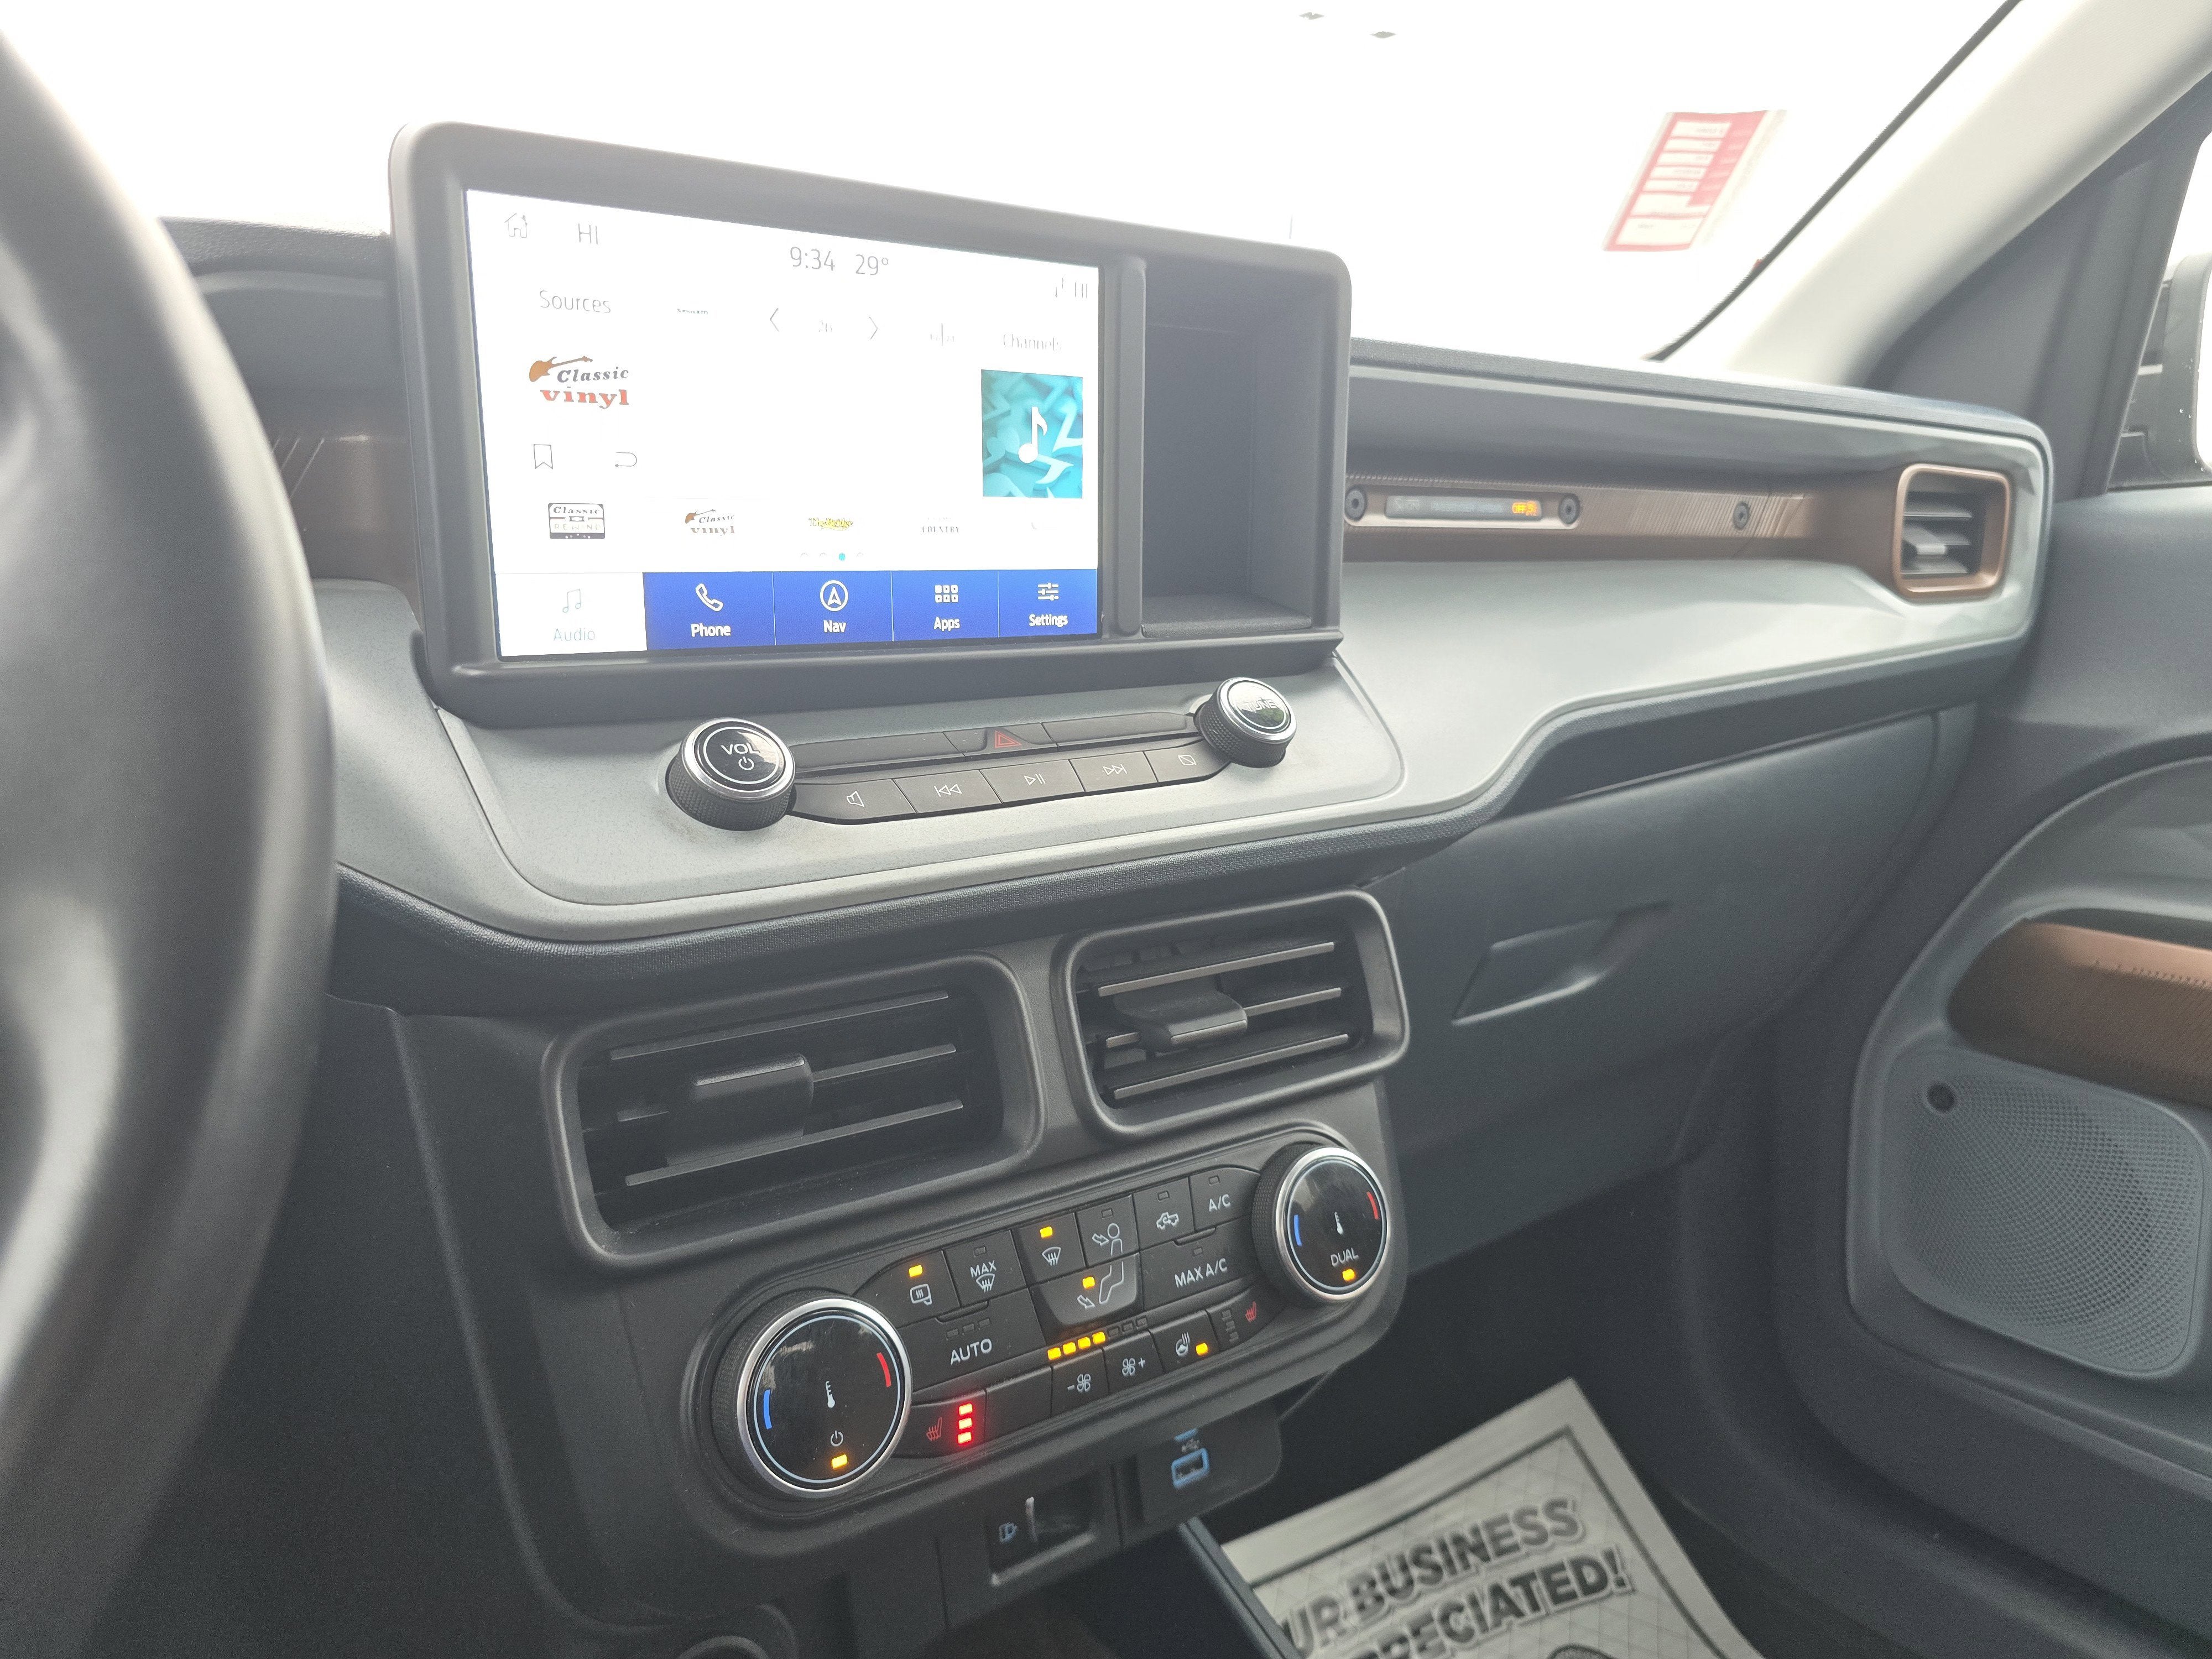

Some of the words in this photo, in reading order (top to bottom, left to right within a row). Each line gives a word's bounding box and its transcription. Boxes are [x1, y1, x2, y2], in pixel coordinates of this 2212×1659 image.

[578, 223, 598, 244] HI
[790, 246, 836, 272] 9:34
[855, 254, 889, 276] 29°
[539, 289, 611, 314] Sources
[557, 366, 629, 383] Classic
[540, 386, 629, 409] vinyl
[823, 620, 847, 633] Nav
[933, 617, 961, 632] Apps
[1029, 613, 1068, 628] Settings
[553, 627, 596, 642] Audio
[690, 623, 732, 638] Phone
[1242, 700, 1279, 711] TUNE
[721, 743, 761, 755] VOL
[1208, 1193, 1232, 1212] A/C
[1330, 1248, 1359, 1267] DUAL
[970, 1260, 997, 1278] MAX
[1174, 1266, 1204, 1288] MAX
[1206, 1258, 1228, 1277] A/C
[950, 1338, 993, 1366] AUTO
[1279, 1594, 1348, 1657] UR
[1350, 1498, 1582, 1615] BUSINESS
[1352, 1548, 1629, 1659] ECIATED!
